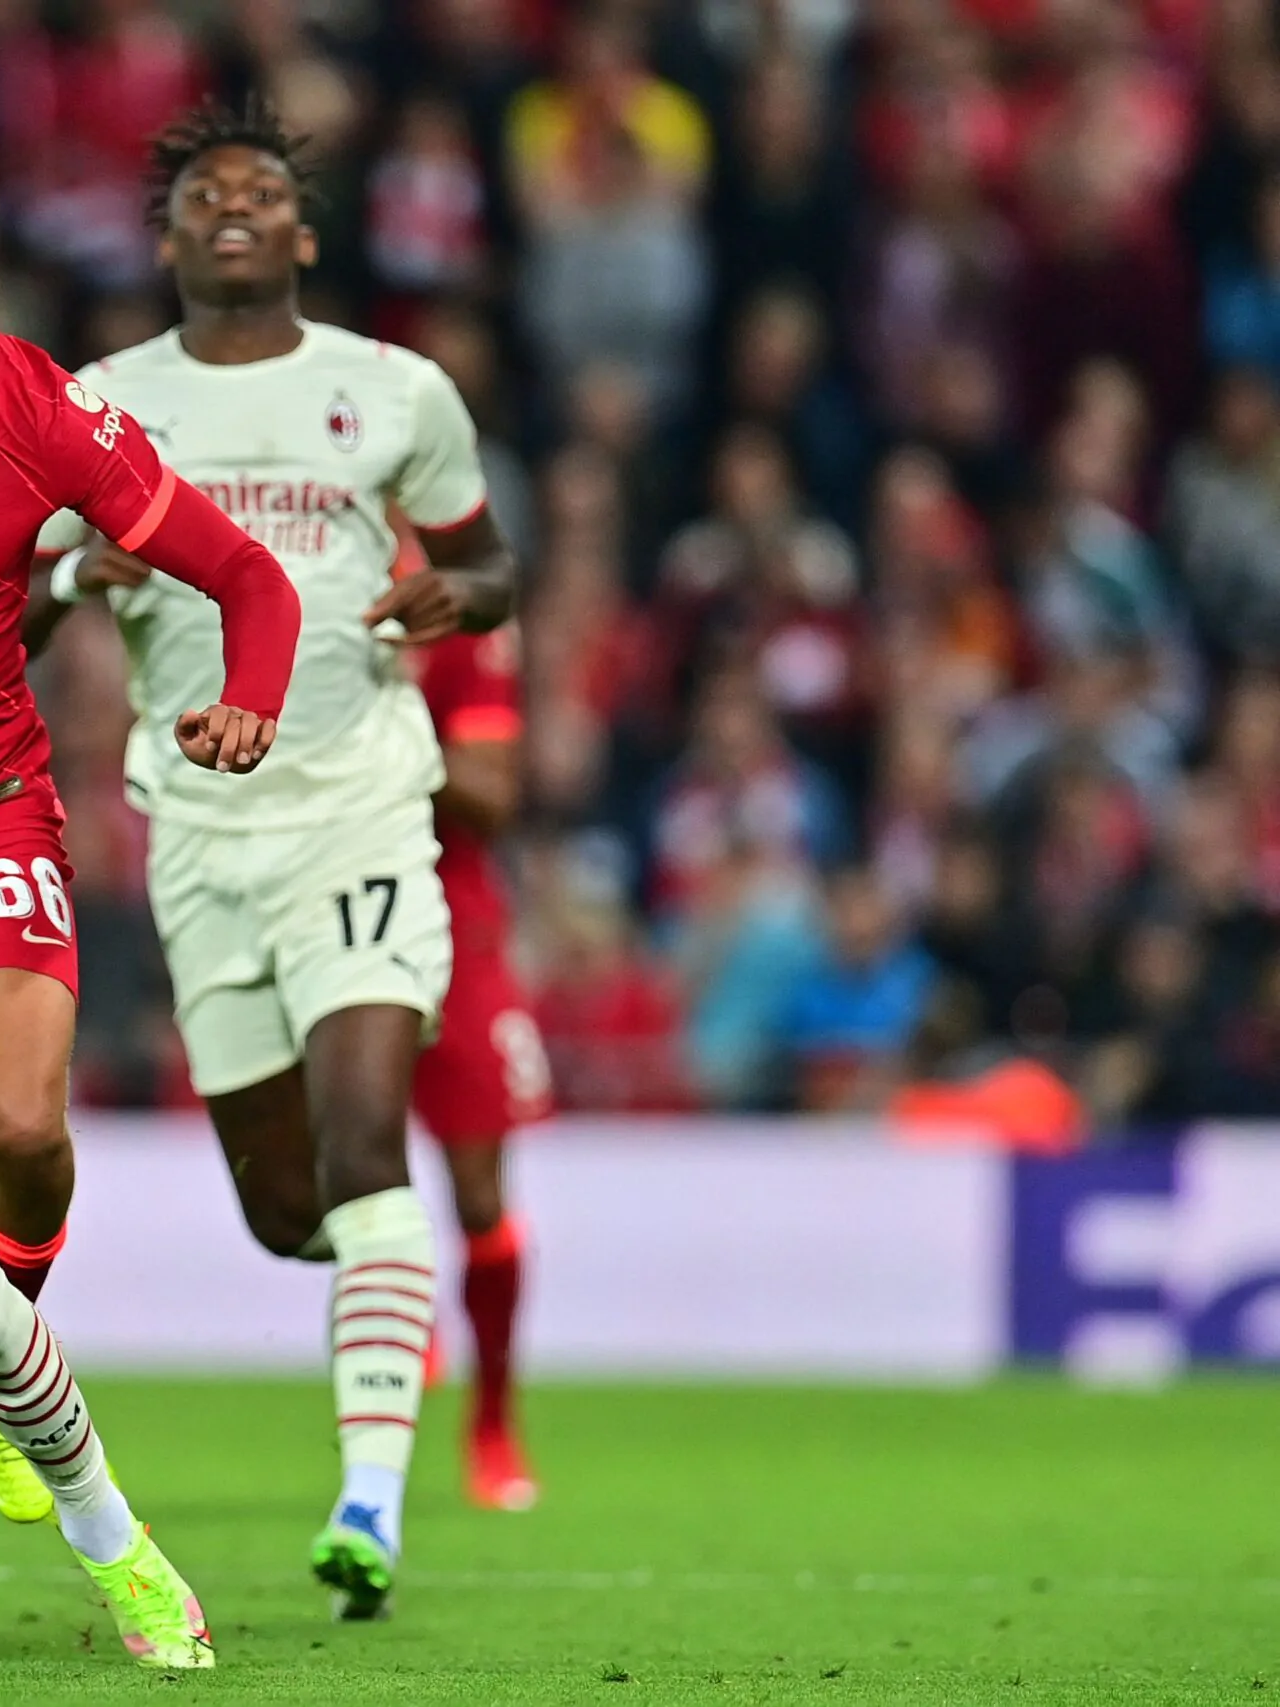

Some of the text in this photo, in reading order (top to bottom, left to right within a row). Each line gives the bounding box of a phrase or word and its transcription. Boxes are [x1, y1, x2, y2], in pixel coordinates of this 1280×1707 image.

[334, 877, 398, 947] 17
[352, 1370, 408, 1391] ACM
[29, 1402, 81, 1448] ACM
